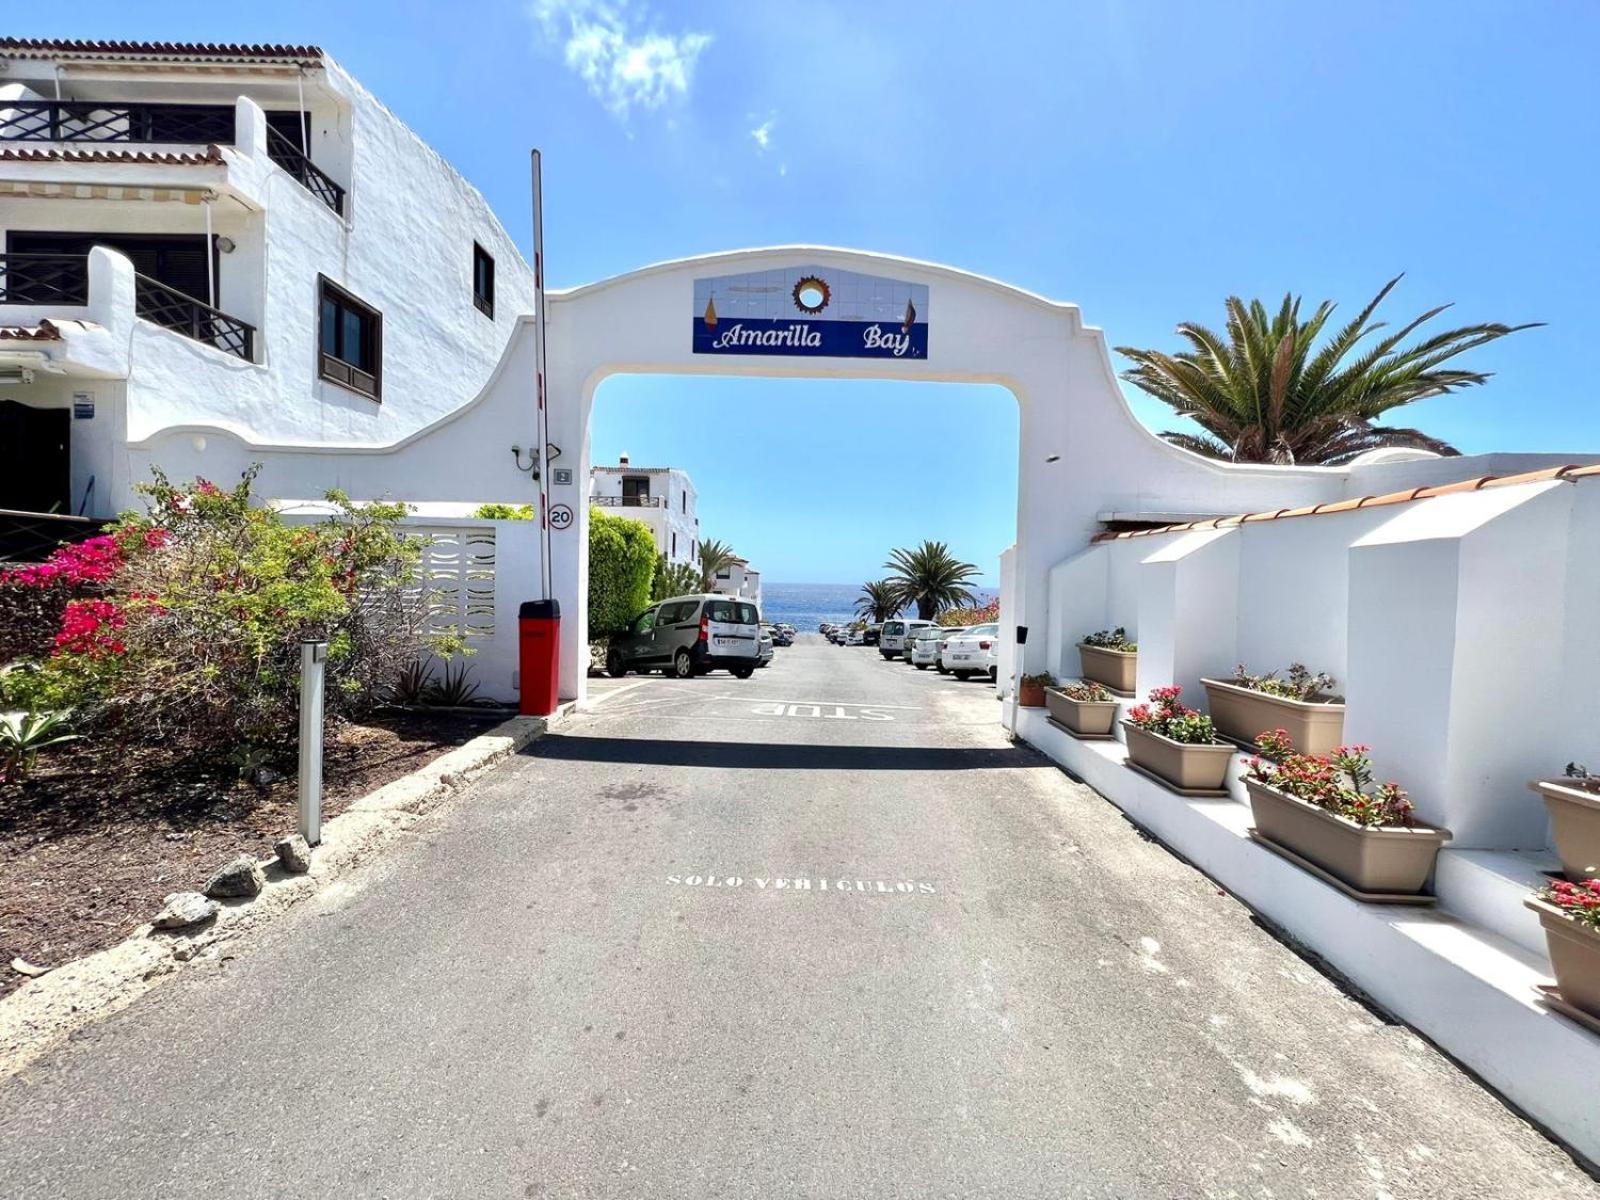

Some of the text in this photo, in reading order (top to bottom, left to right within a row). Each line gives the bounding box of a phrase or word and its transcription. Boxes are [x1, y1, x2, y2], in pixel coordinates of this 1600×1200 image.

[713, 323, 910, 356] Amarilla Bay
[551, 511, 570, 523] 20
[751, 702, 897, 721] STOP
[665, 874, 744, 887] SOLO
